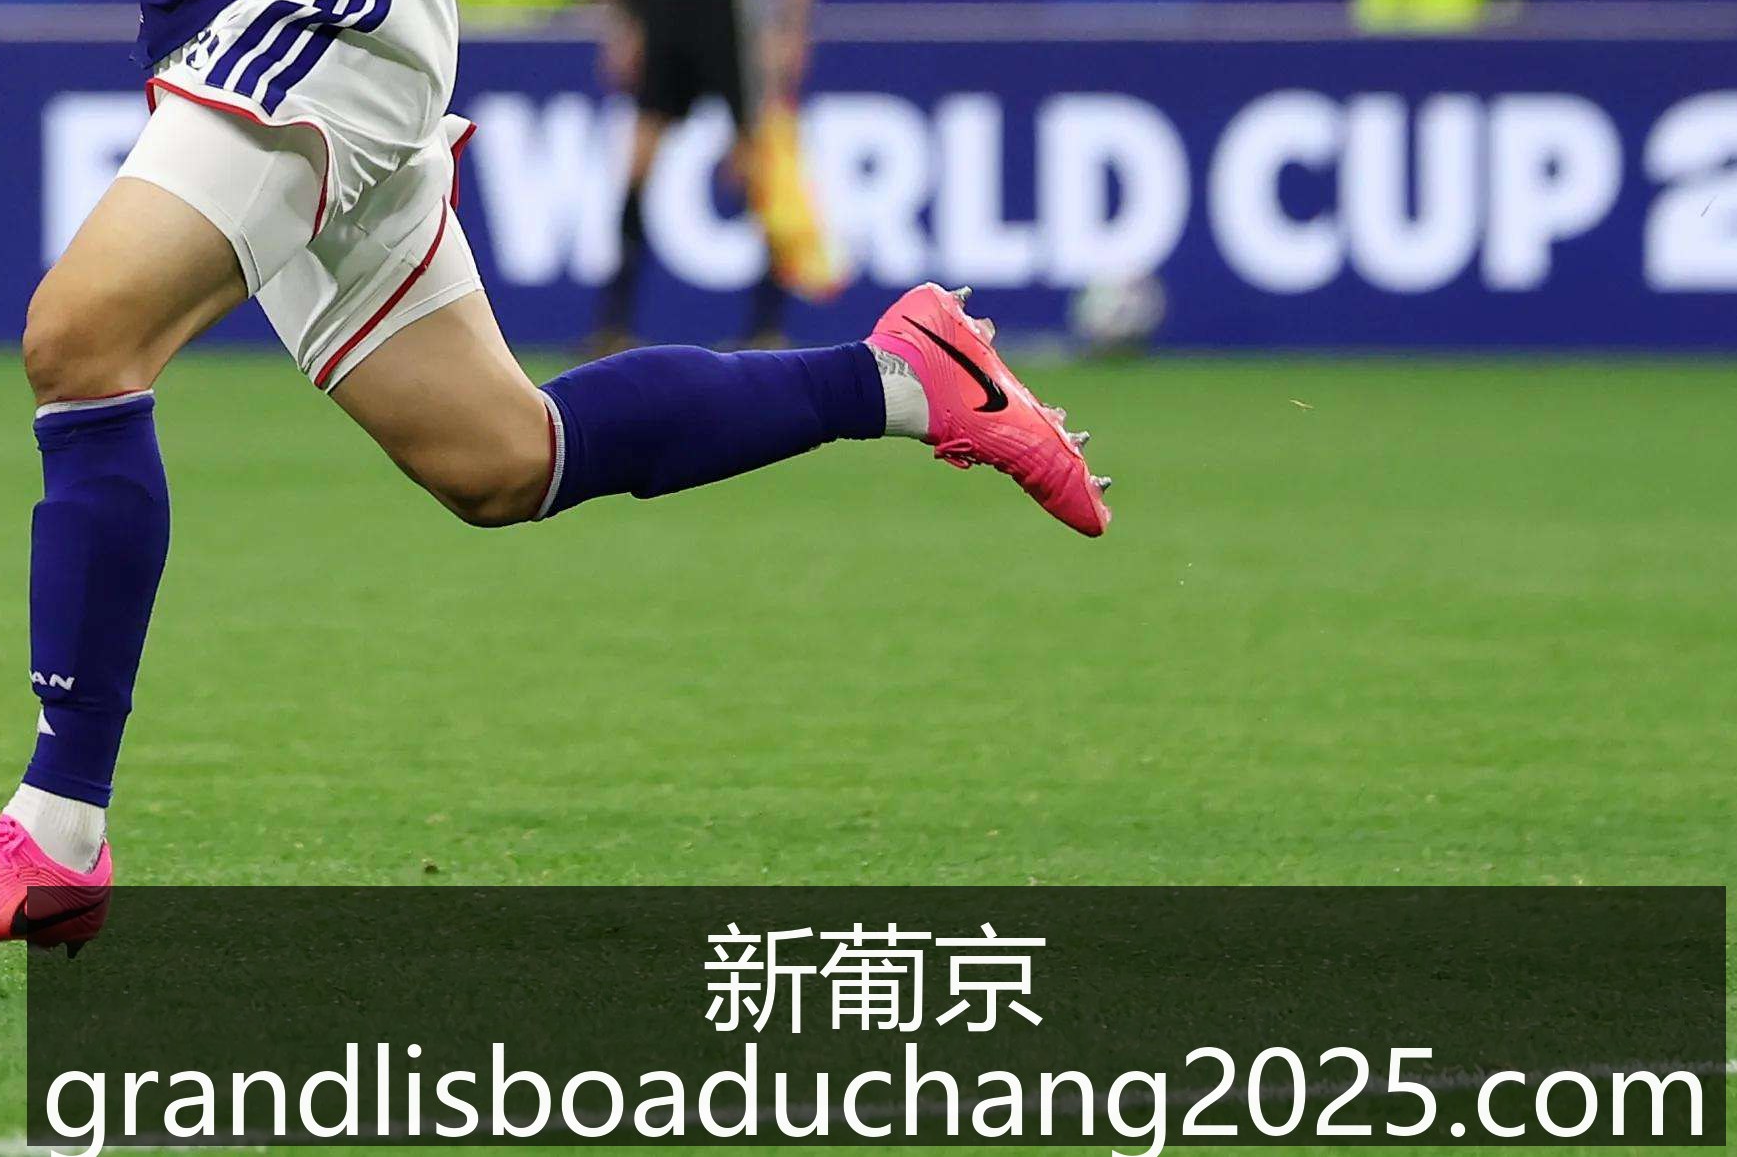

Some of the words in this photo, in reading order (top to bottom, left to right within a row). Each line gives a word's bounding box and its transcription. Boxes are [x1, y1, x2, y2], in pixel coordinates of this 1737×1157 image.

[471, 91, 1191, 291] WORLD
[1209, 89, 1624, 292] CUP
[30, 671, 75, 691] AN
